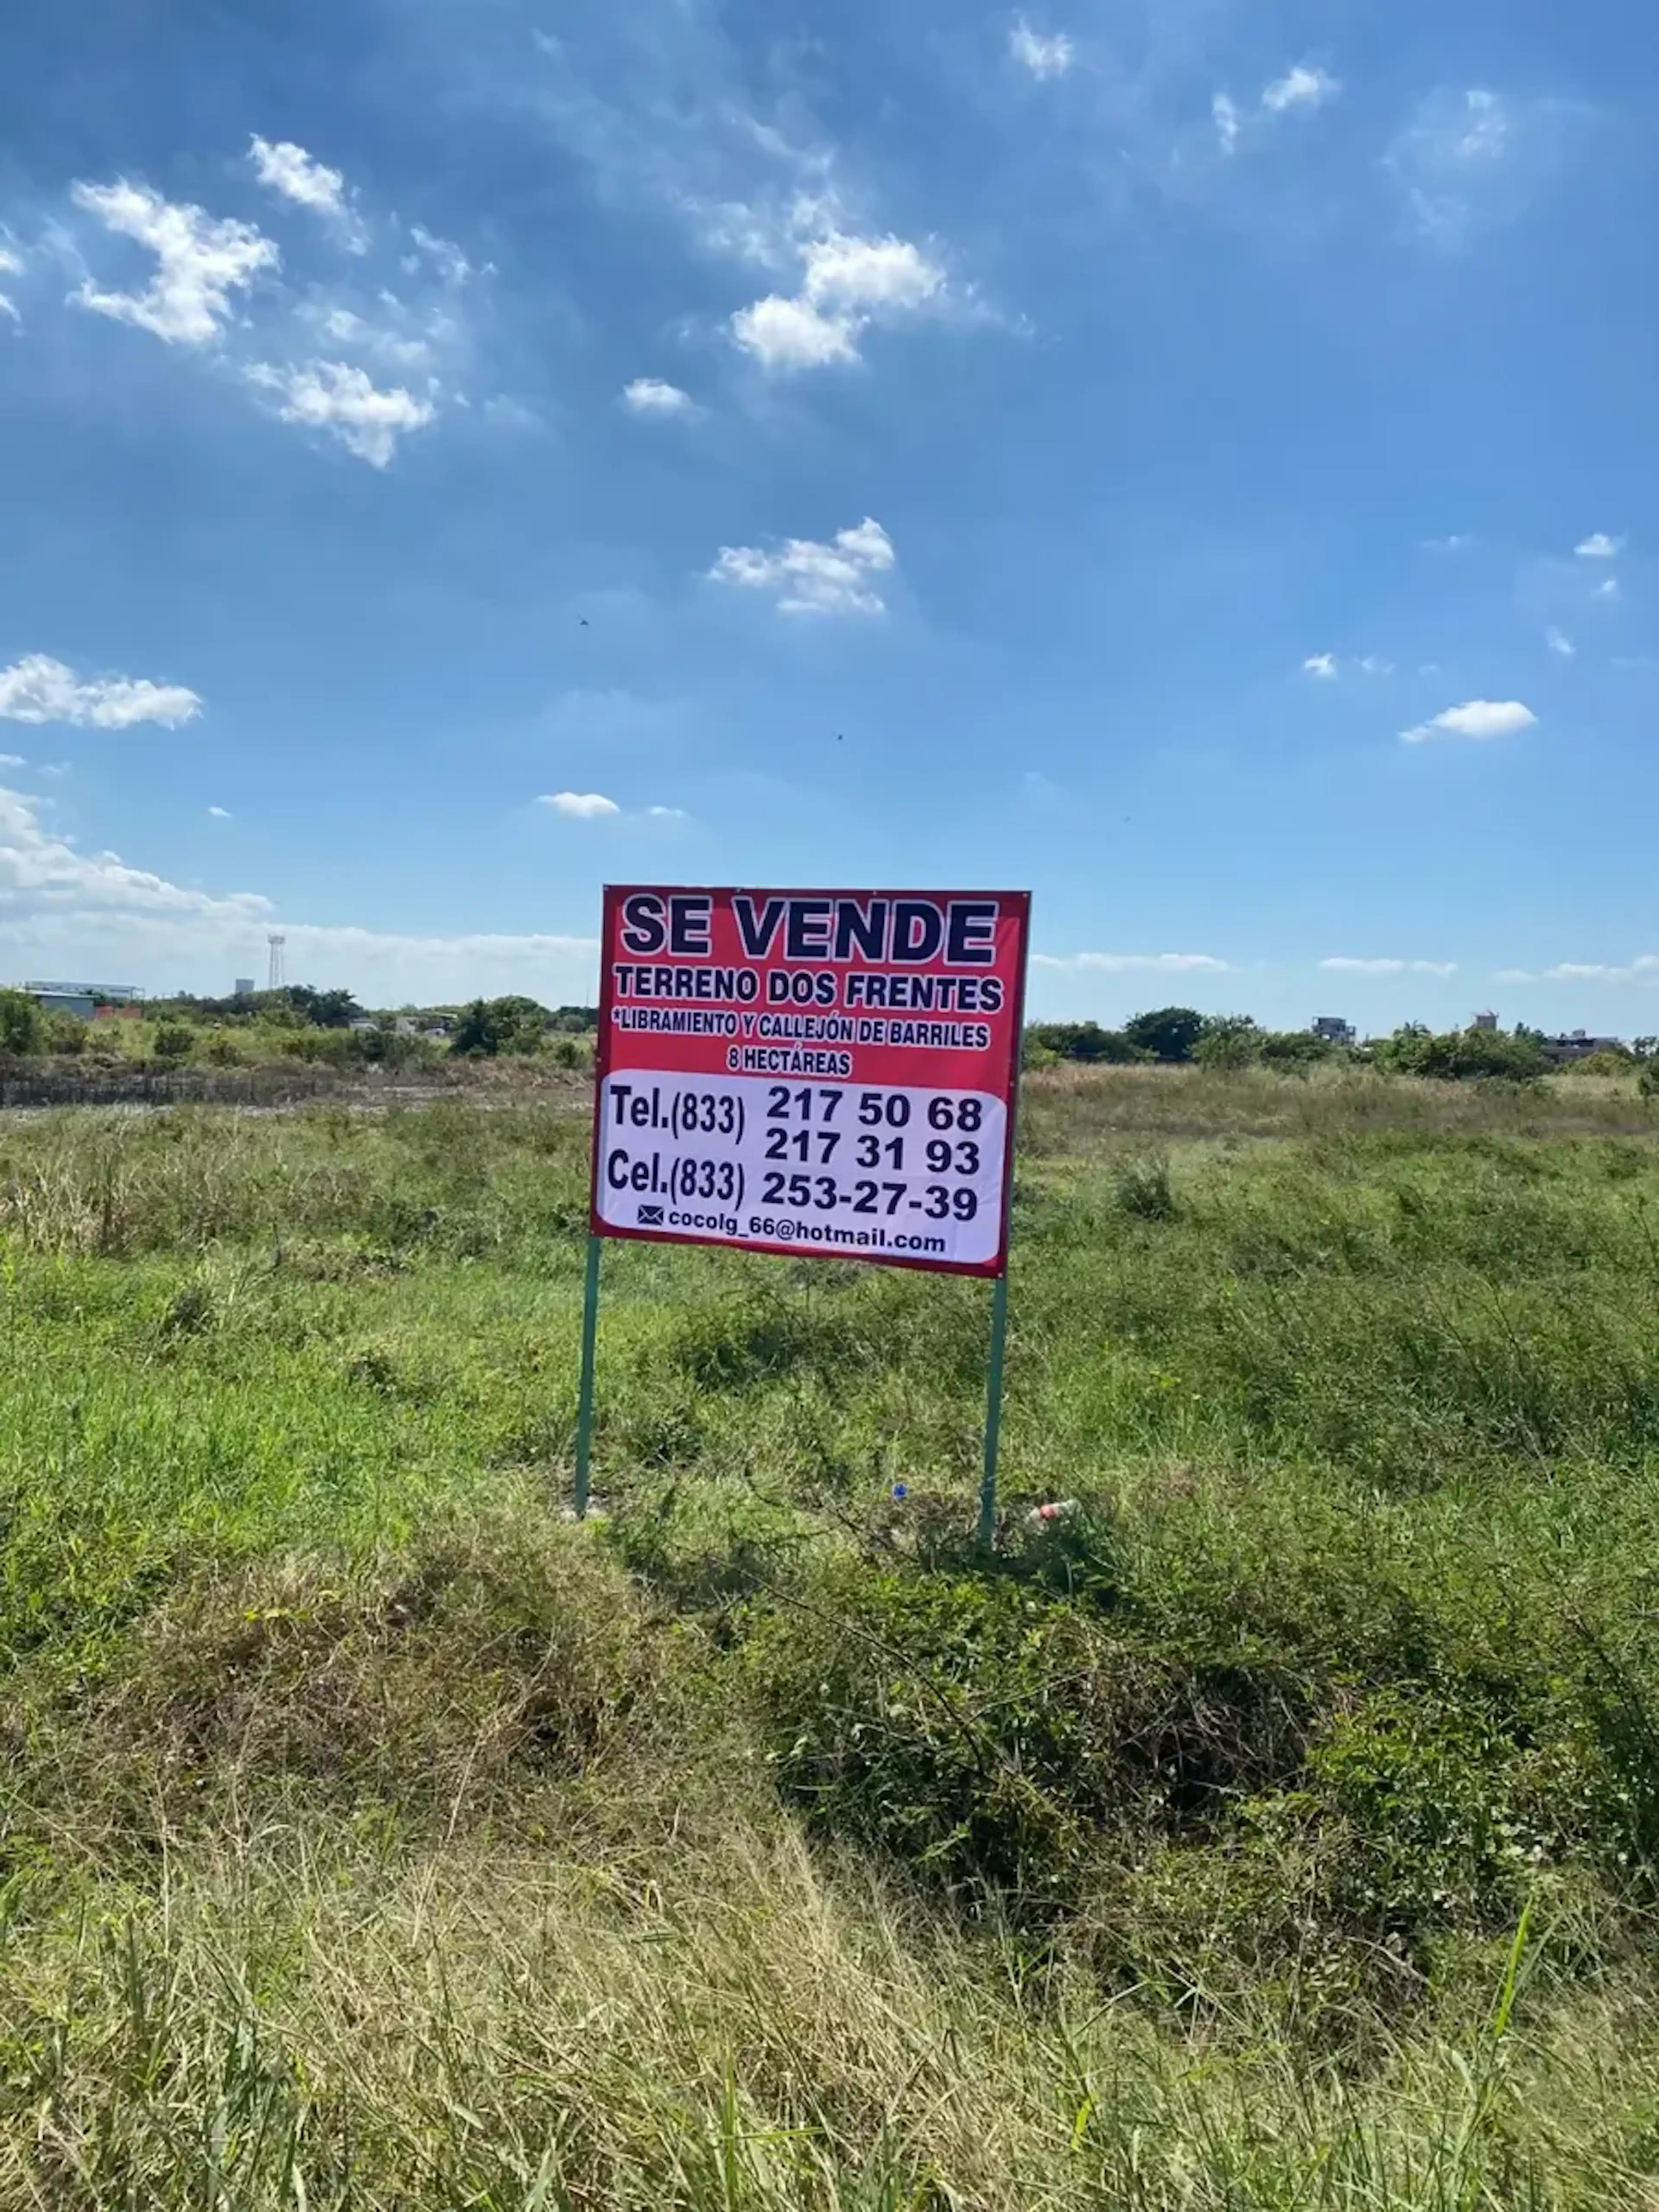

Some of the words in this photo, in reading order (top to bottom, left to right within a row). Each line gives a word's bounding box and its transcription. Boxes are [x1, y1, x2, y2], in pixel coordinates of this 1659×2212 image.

[620, 893, 712, 957] SE
[732, 895, 999, 966] VENDE
[614, 965, 758, 1004] TERRENO
[769, 969, 836, 1007] DOS
[845, 973, 1004, 1014] FRENTES
[742, 1014, 754, 1037] Y
[759, 1011, 854, 1042] CALLEJÓN
[860, 1019, 884, 1043] DE
[889, 1021, 990, 1049] BARRILES
[727, 1047, 740, 1070] 8
[743, 1044, 852, 1076] HECTÁREAS
[767, 1086, 843, 1122] 217
[858, 1093, 910, 1127] 50
[928, 1097, 982, 1132] 68
[765, 1128, 840, 1163] 217
[856, 1135, 904, 1170] 31
[926, 1140, 980, 1175] 93
[762, 1172, 977, 1222] 253-27-39
[669, 1210, 946, 1252] cocolg_66@hotmail.com
